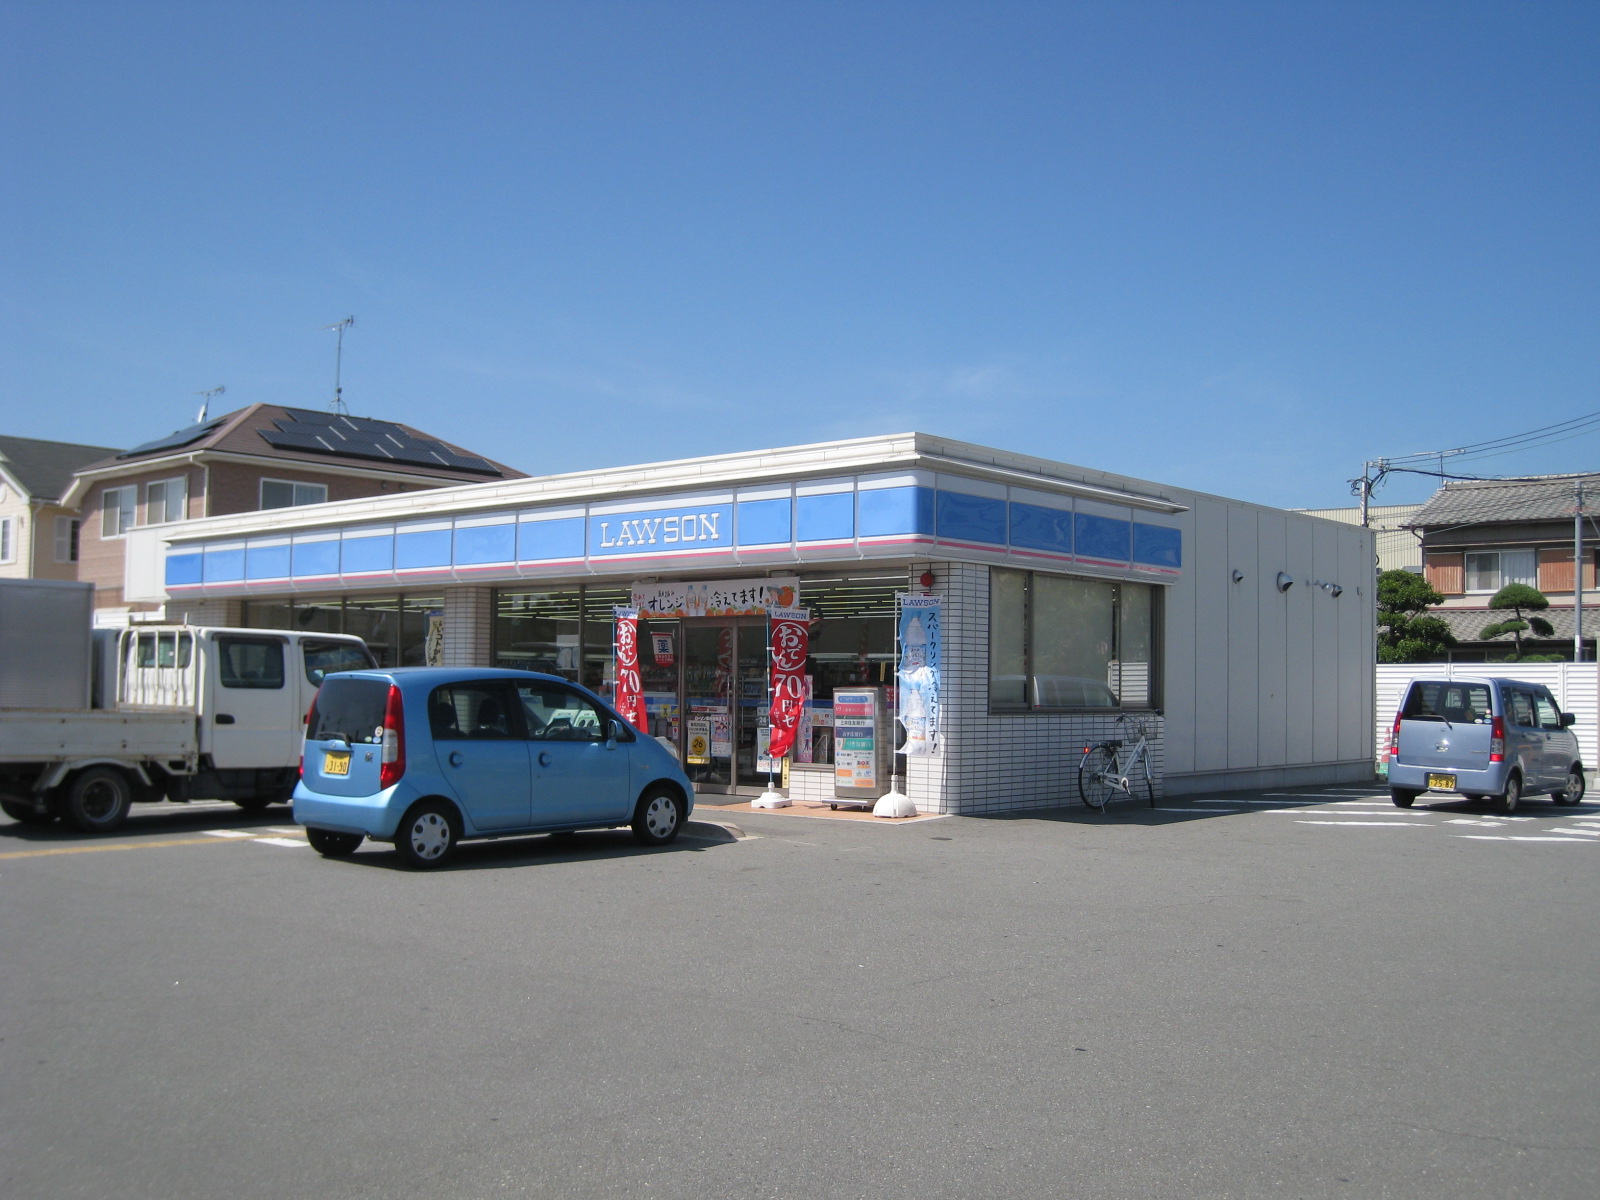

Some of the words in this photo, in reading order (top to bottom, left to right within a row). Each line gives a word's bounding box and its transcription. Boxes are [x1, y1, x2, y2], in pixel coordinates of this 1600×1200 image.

[600, 513, 720, 548] LAWSON
[648, 596, 684, 611] オレンジ
[902, 598, 940, 607] LAWSON
[774, 611, 807, 620] LAWSON
[616, 623, 634, 664] おでん
[657, 639, 670, 653] 薬
[779, 625, 803, 668] おでん
[693, 739, 703, 748] 26
